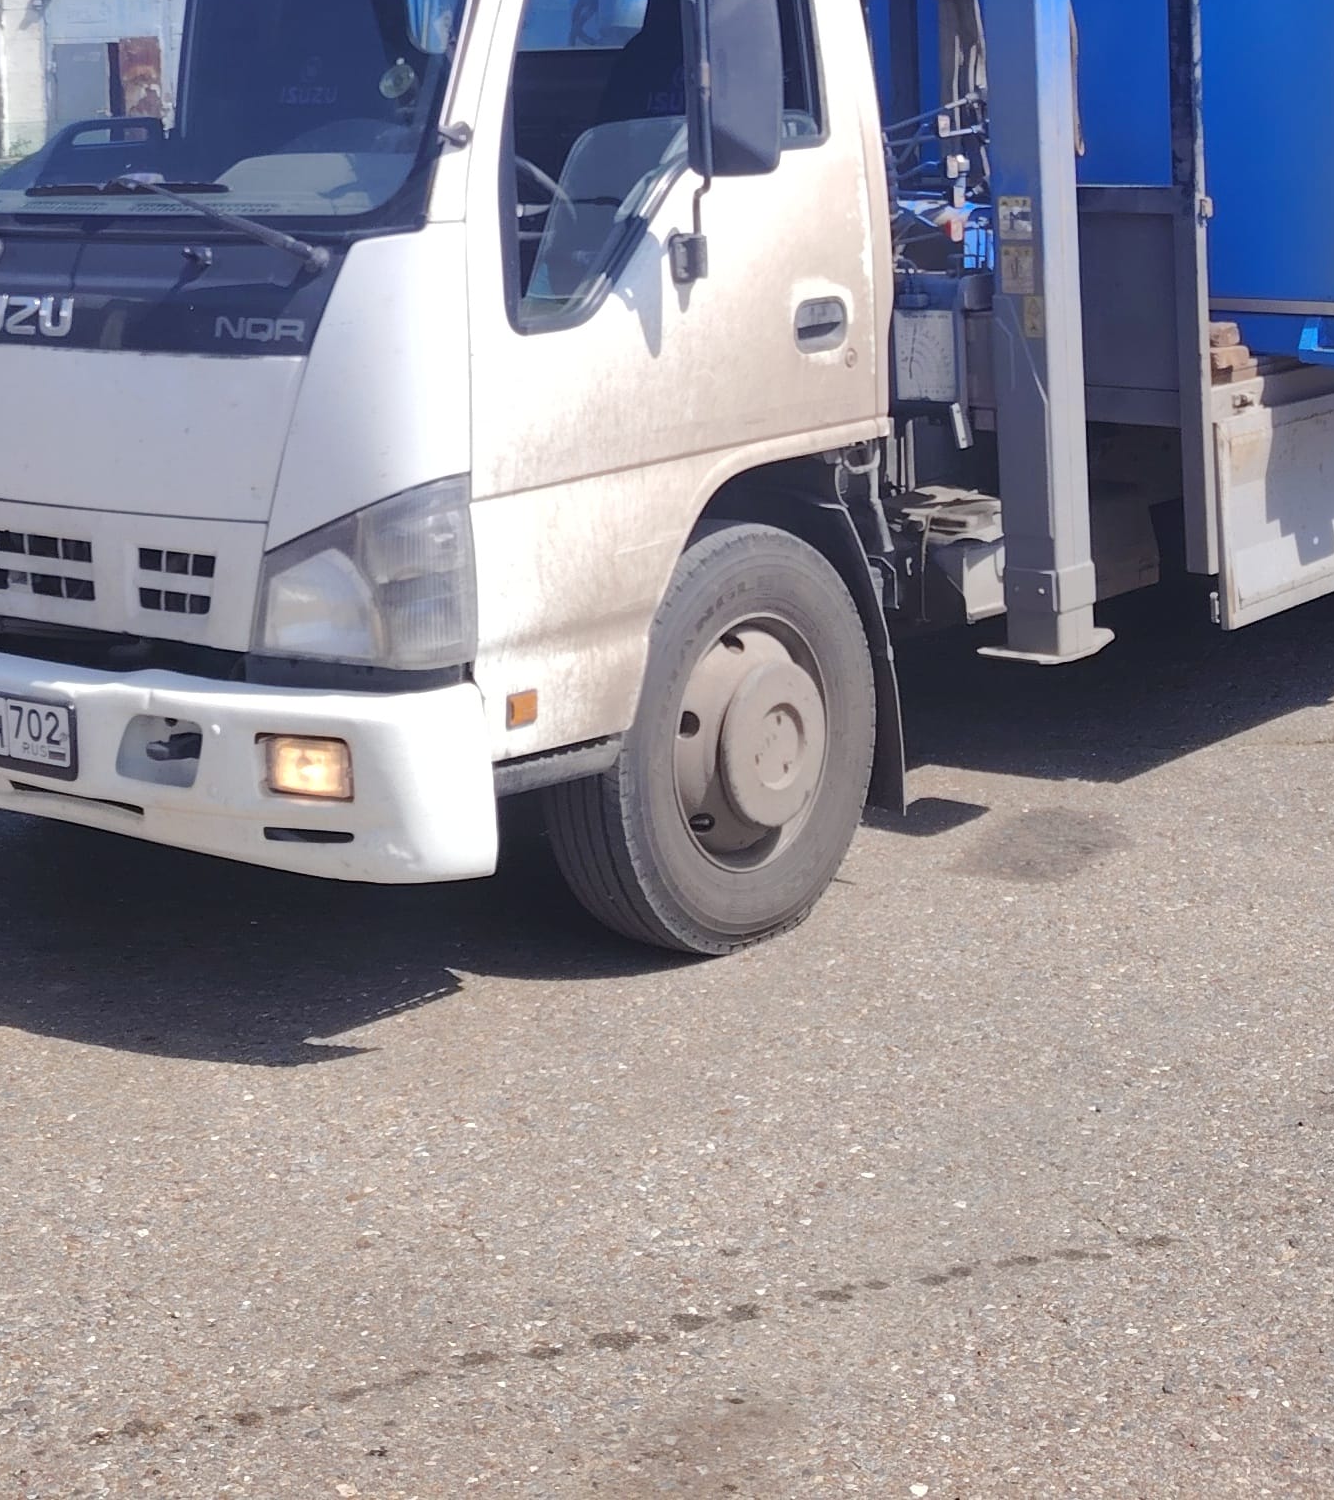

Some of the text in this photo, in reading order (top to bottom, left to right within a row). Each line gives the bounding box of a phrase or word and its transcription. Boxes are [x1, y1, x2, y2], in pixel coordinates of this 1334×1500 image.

[215, 315, 305, 342] NQR
[10, 704, 61, 746] 702
[22, 742, 48, 757] RUS
